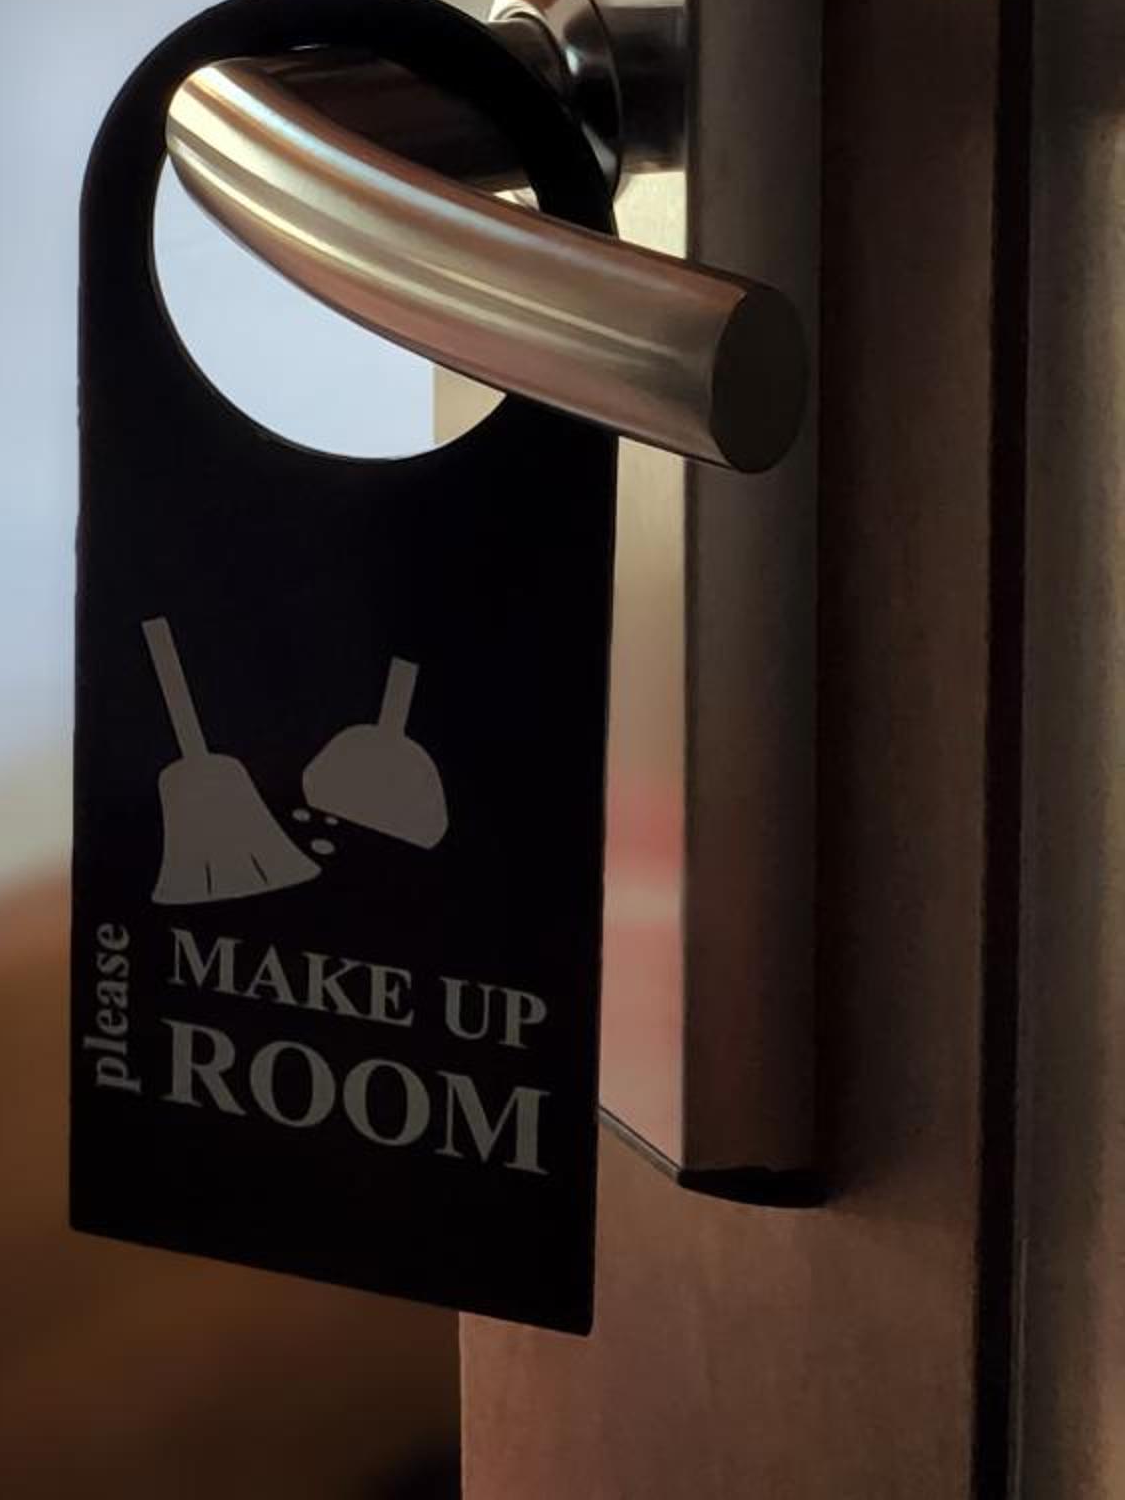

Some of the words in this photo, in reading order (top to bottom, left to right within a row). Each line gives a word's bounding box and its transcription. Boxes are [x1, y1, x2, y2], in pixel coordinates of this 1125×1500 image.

[83, 922, 142, 1094] please
[168, 927, 414, 1027] MAKE
[439, 976, 548, 1049] UP
[161, 1017, 550, 1175] ROOM
